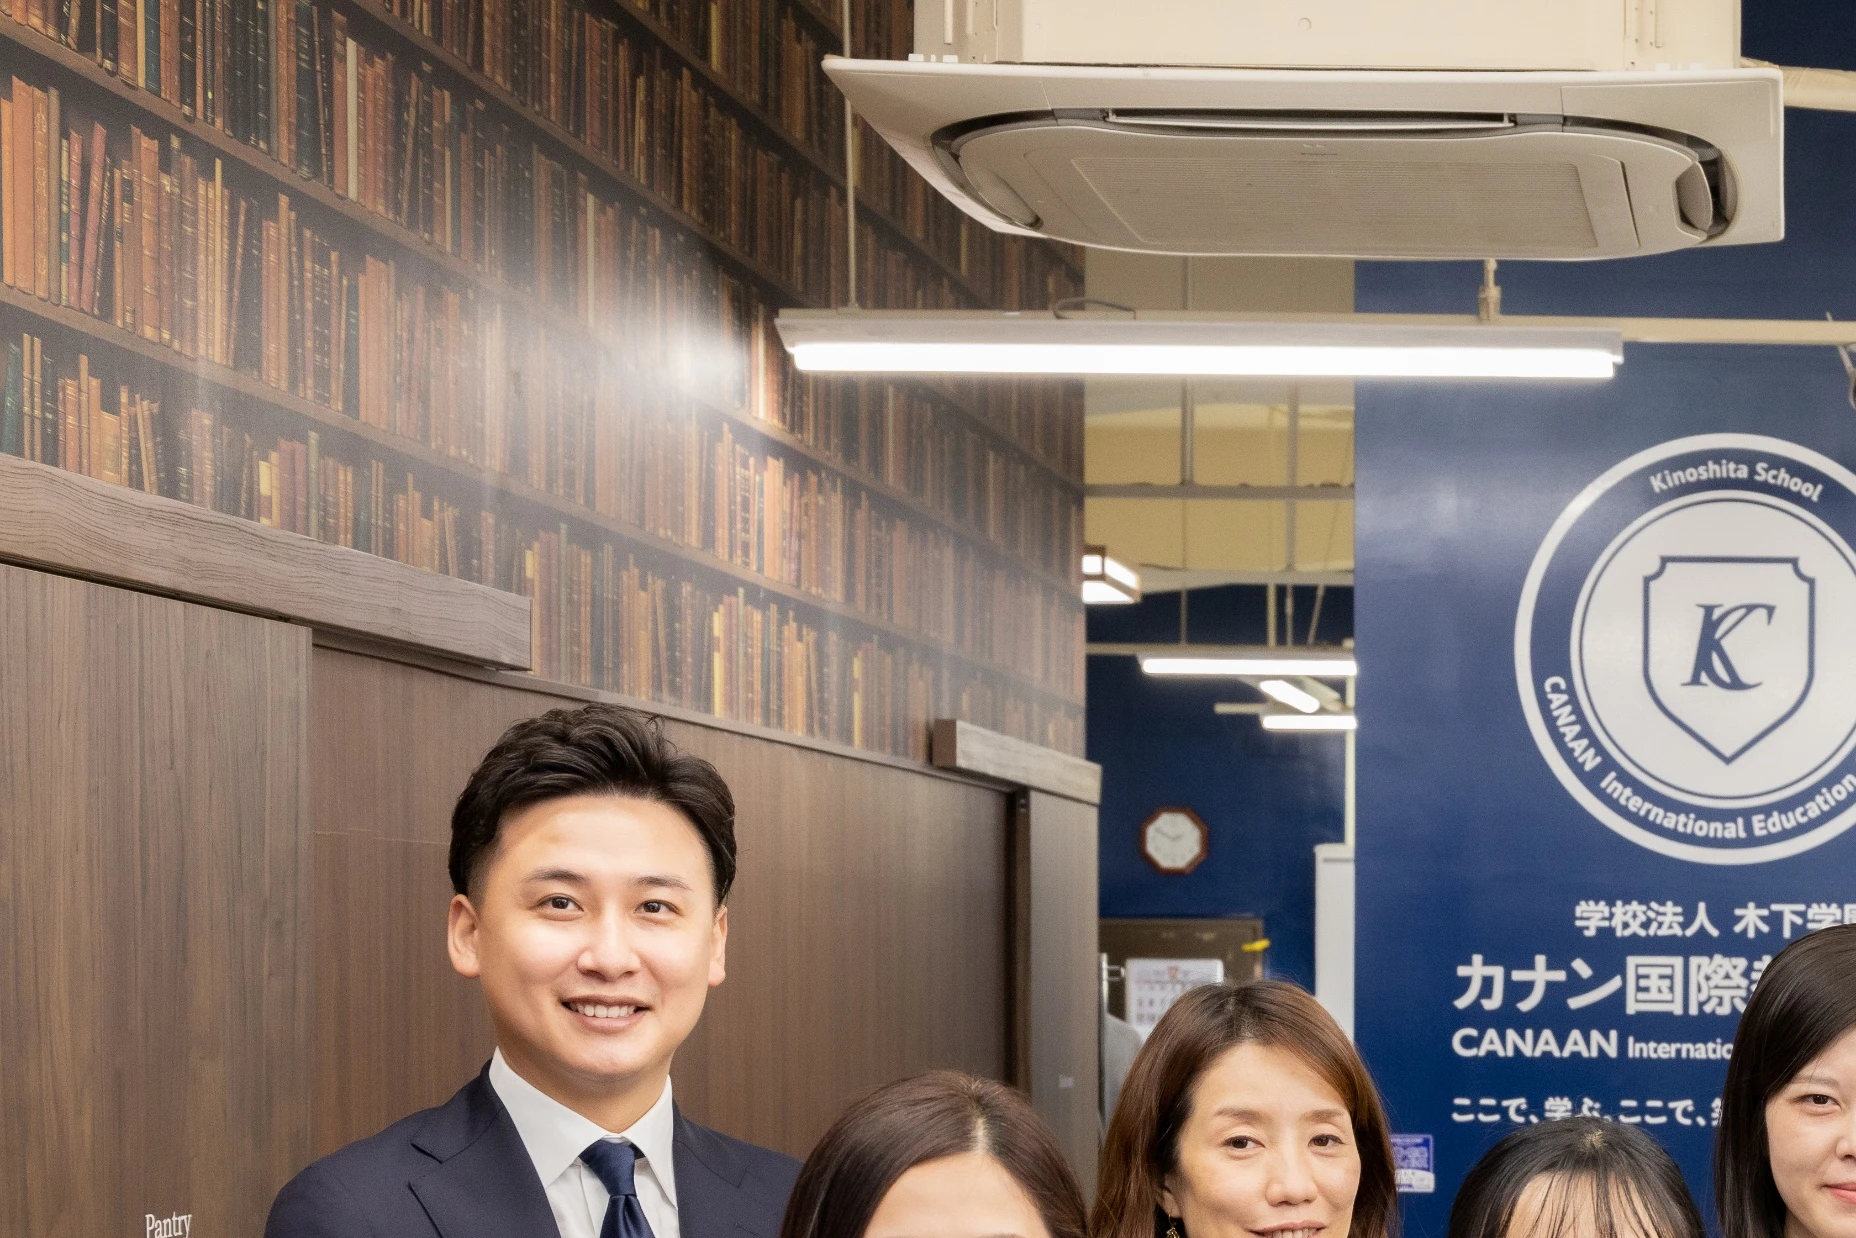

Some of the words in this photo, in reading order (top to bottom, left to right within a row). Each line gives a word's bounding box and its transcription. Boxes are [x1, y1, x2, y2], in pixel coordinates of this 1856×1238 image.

[1649, 460, 1749, 494] Kinoshita
[1754, 461, 1825, 503] School
[1543, 674, 1601, 772] CANAAN
[1600, 770, 1747, 840] International
[1574, 900, 1720, 938] 学校法人
[1451, 1027, 1618, 1058] CANAAN
[1627, 1036, 1734, 1060] Internatio
